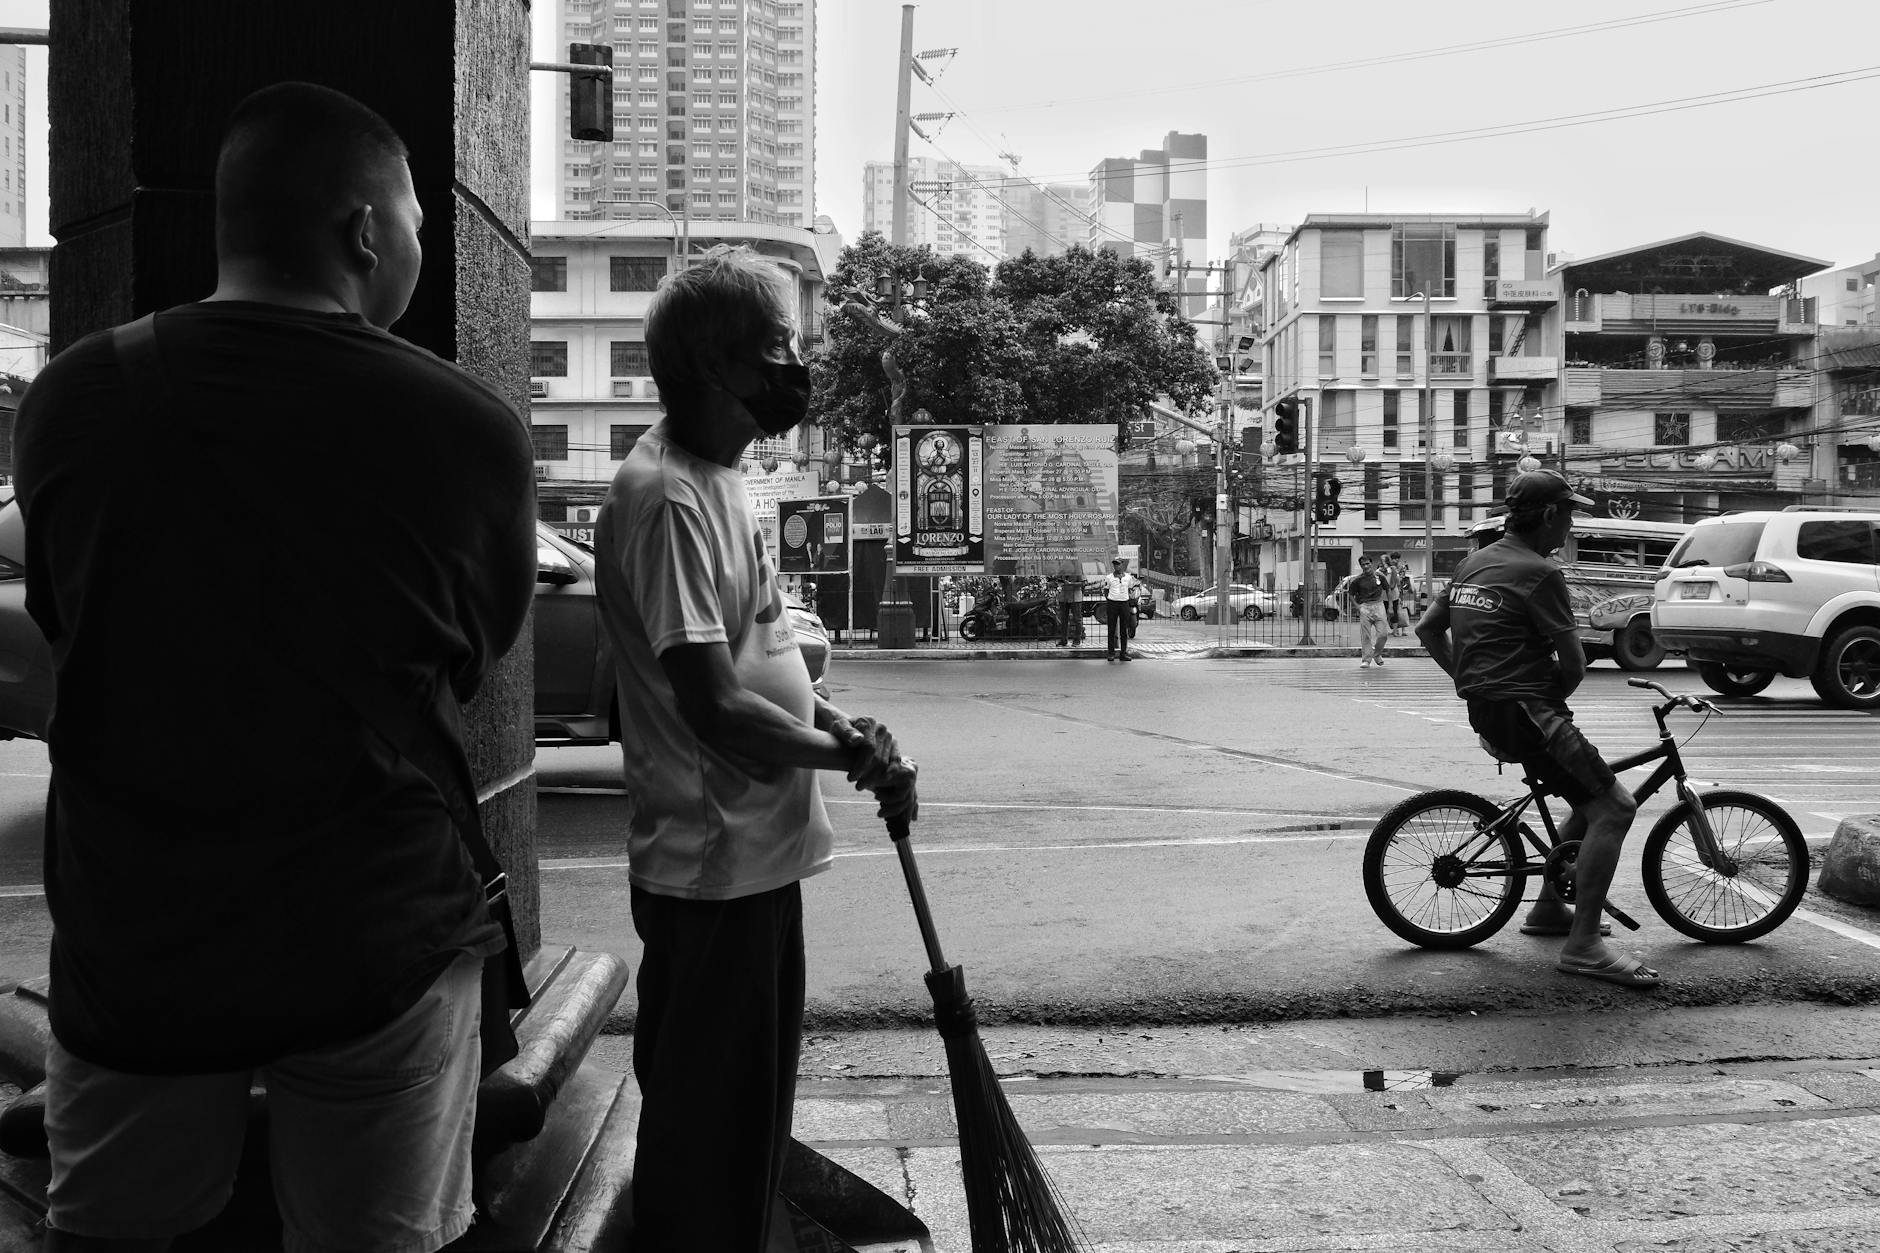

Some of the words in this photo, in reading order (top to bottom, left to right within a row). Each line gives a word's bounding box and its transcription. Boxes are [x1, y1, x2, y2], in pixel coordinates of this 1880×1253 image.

[1134, 423, 1145, 433] St
[786, 475, 806, 483] MANILA
[917, 533, 964, 545] LORENZO
